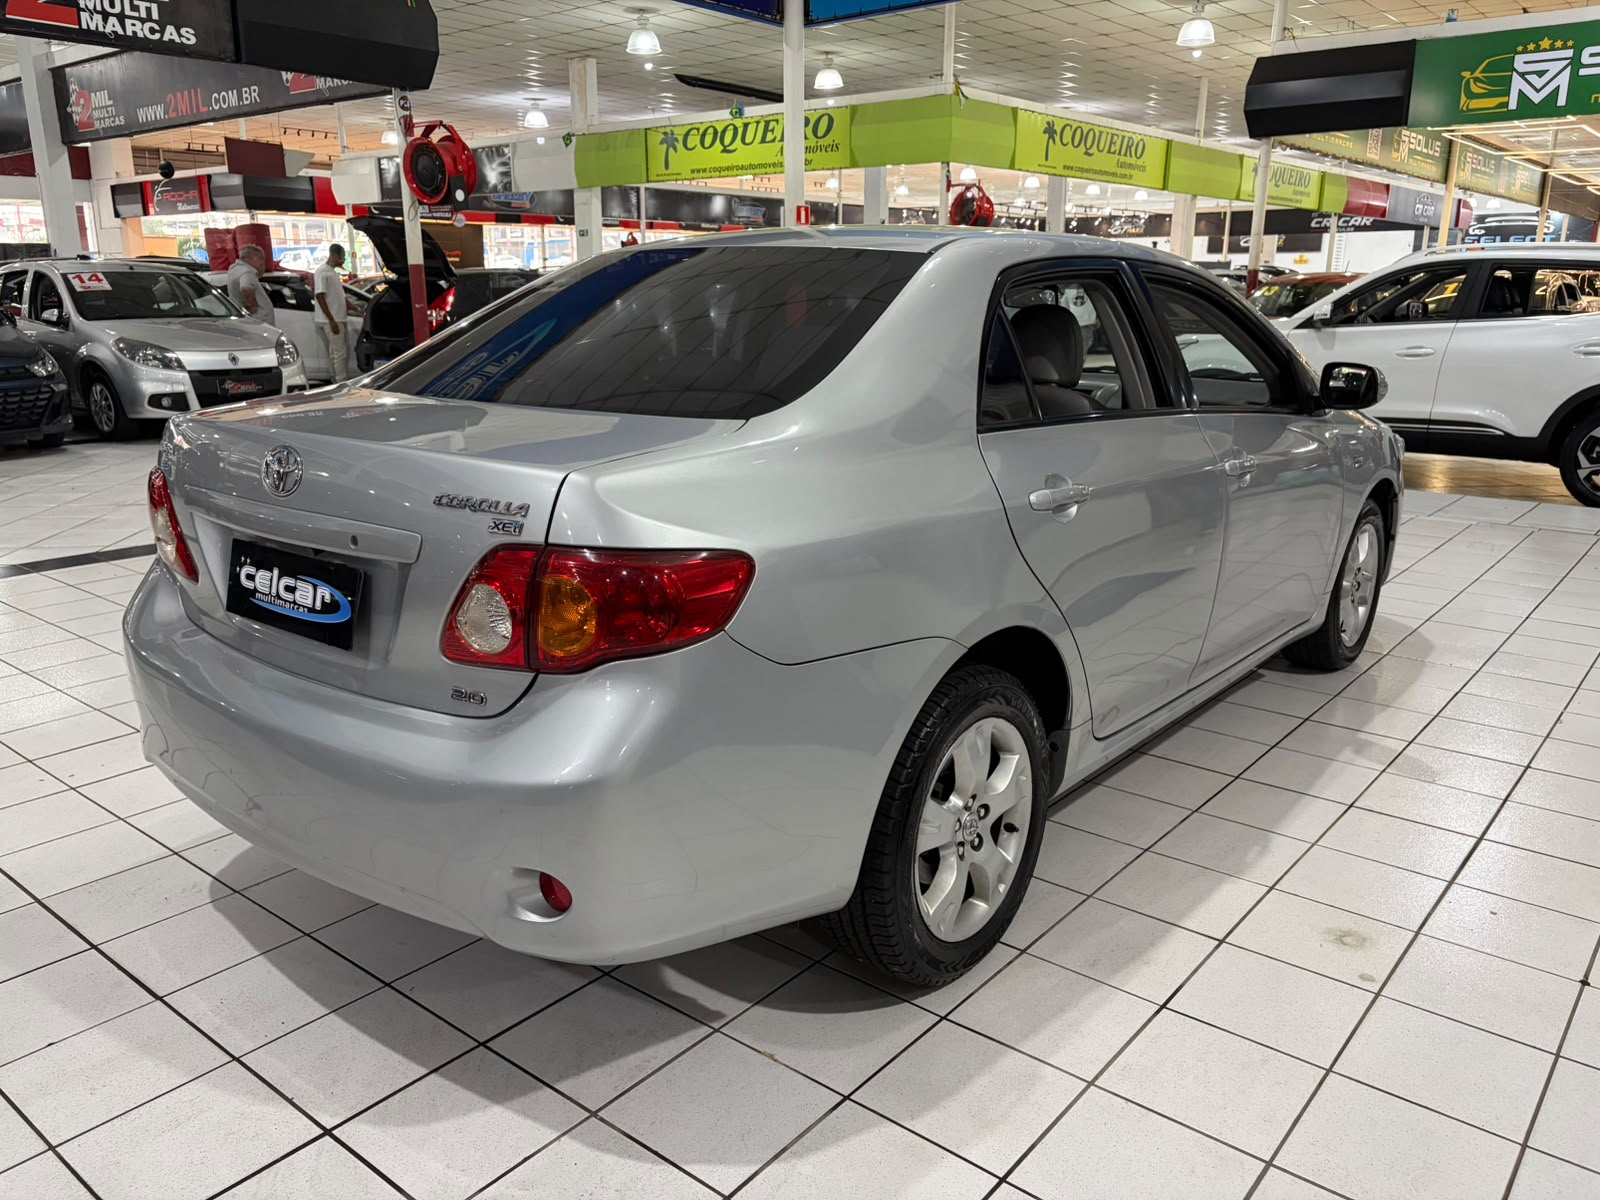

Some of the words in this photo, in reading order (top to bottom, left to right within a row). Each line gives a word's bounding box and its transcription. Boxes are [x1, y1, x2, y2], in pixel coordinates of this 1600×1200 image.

[78, 0, 160, 20] MULTI
[80, 12, 197, 45] MARCAS
[91, 90, 114, 107] MIL
[136, 86, 261, 124] WWW.2MIL.COM.BR
[92, 107, 116, 119] MULTI
[94, 115, 126, 129] MARCAS
[1059, 123, 1147, 160] COQUEIRO
[1409, 133, 1442, 158] SOLUS
[1337, 216, 1374, 227] CAR
[72, 273, 105, 285] 14
[433, 493, 531, 518] COROLLA
[240, 564, 331, 610] celcar
[255, 592, 309, 613] multimarcas
